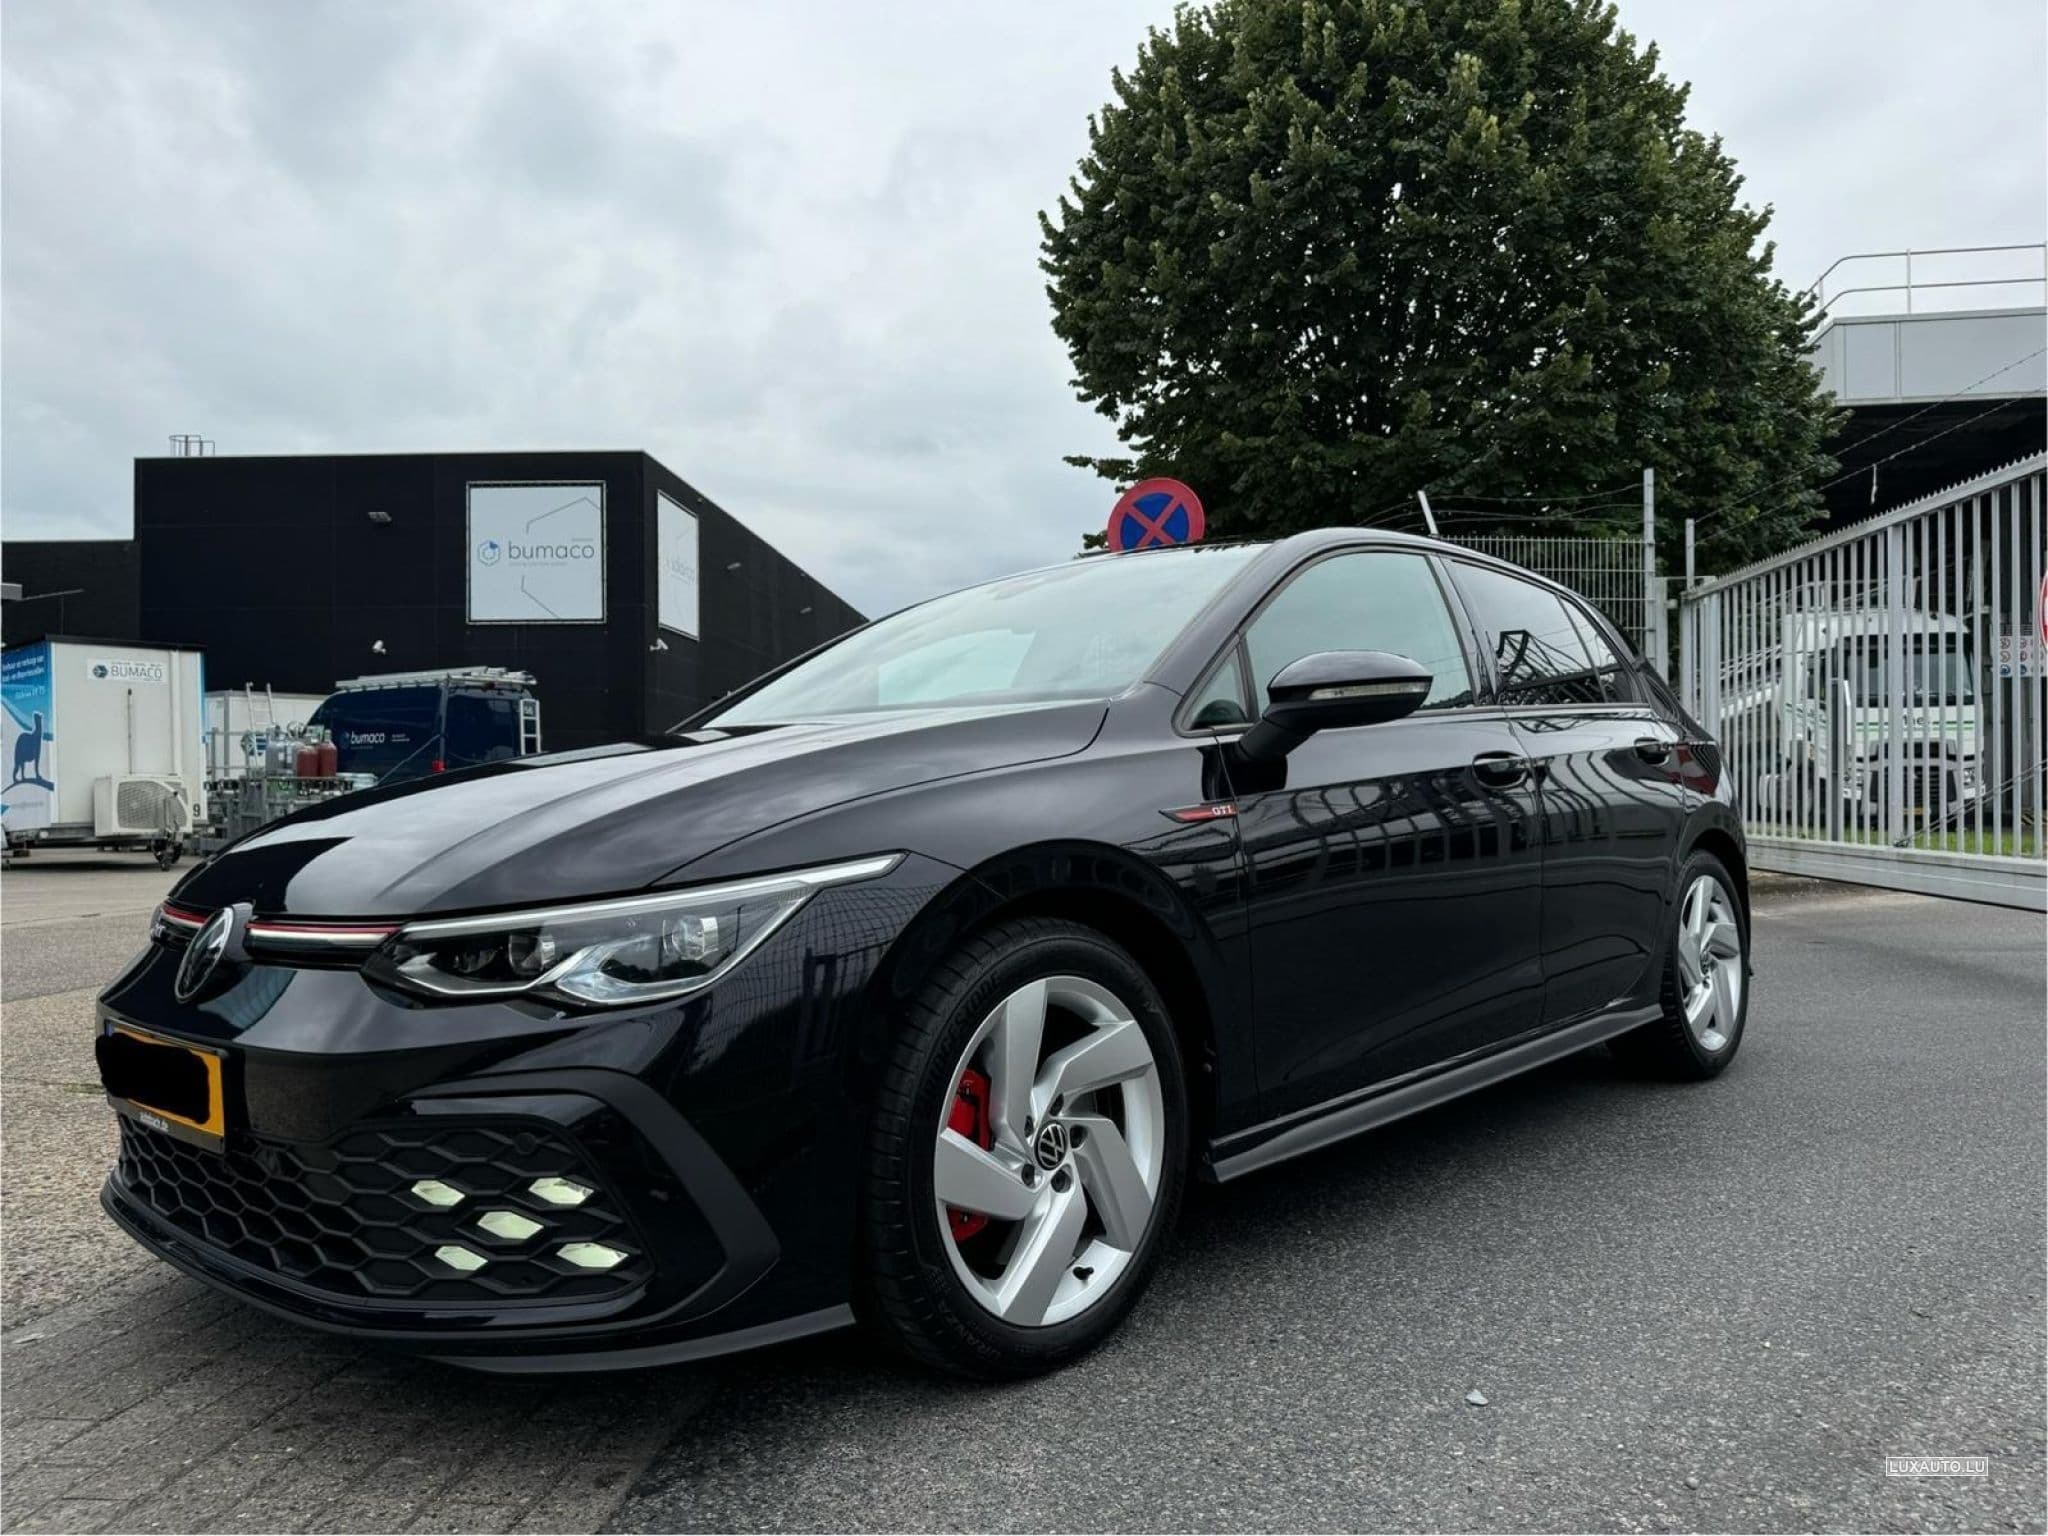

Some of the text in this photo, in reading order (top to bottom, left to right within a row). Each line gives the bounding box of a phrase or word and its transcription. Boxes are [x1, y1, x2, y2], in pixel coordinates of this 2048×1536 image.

[508, 540, 595, 560] bumaco
[111, 665, 163, 679] BUMACO
[350, 731, 385, 744] bumaco
[1212, 804, 1232, 816] GTI
